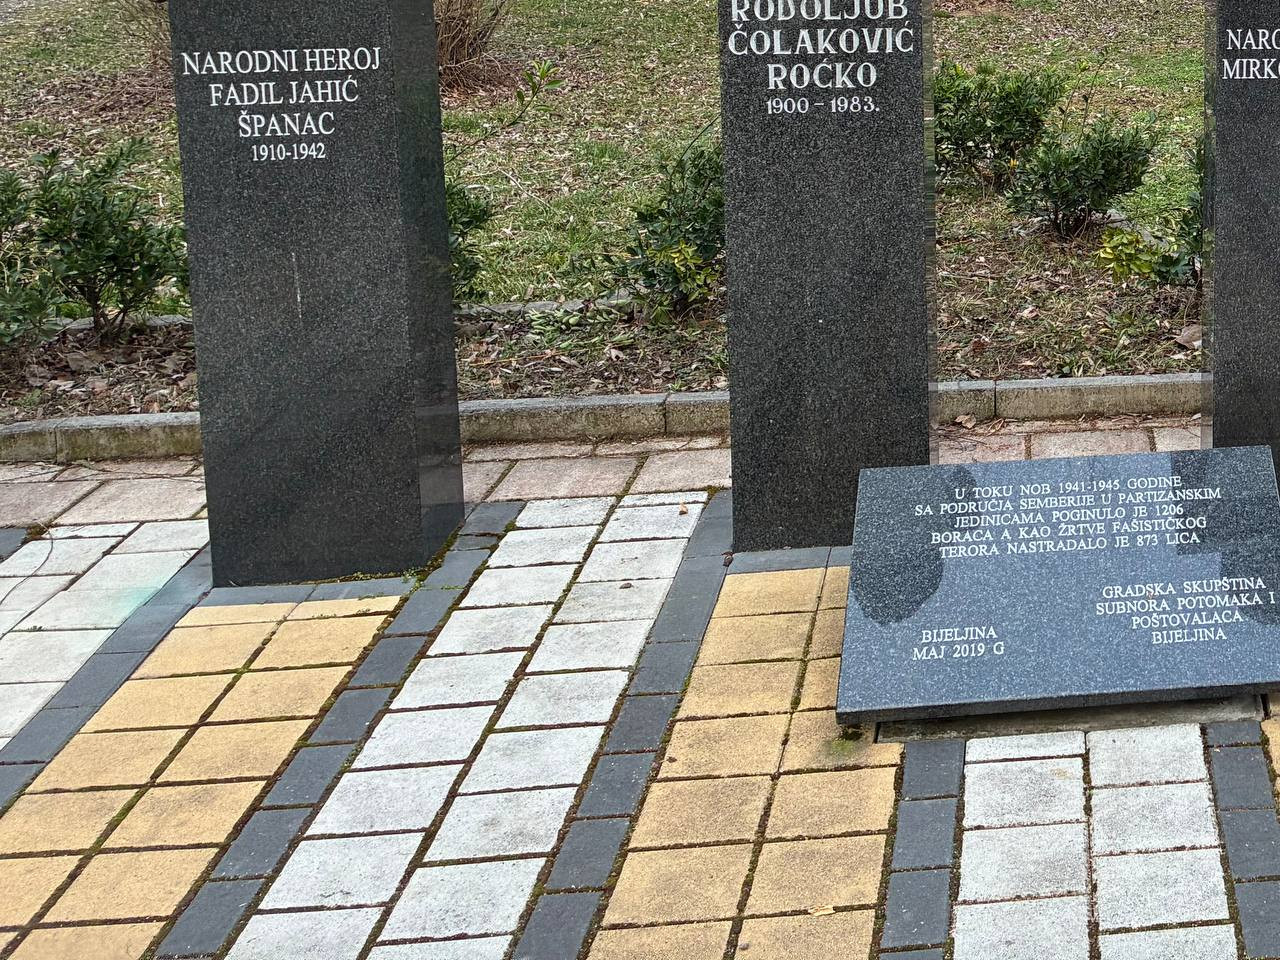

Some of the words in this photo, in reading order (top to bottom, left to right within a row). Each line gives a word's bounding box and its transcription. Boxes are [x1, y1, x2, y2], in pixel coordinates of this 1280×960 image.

[728, 21, 914, 56] ČOLAKOVIĆ
[181, 48, 298, 75] NARODNI
[303, 46, 381, 72] HEROJ
[767, 58, 877, 90] ROĆKO
[209, 81, 284, 107] FADIL
[289, 75, 359, 104] JAHIĆ
[767, 97, 809, 115] 1900
[830, 96, 880, 113] 1983.
[238, 110, 335, 138] ŠPANAC
[251, 142, 326, 162] 1910-1942
[955, 488, 965, 499] U
[972, 485, 1013, 499] TOKU
[1020, 483, 1051, 496] NOB
[1059, 479, 1120, 494] 1941-1945
[1127, 476, 1182, 490] GODINE
[915, 504, 933, 516] SA
[940, 499, 1013, 515] PODRUČJA
[1020, 495, 1095, 510] SEMBERIJE
[1101, 493, 1111, 505] U
[1118, 487, 1222, 504] PARTIZANSKIM
[954, 512, 1045, 528] JEDINICAMA
[1052, 507, 1126, 523] POGINULO
[1132, 506, 1147, 518] JE
[1156, 504, 1184, 516] 1206
[931, 529, 994, 544] BORACA
[1001, 528, 1012, 540] A
[1018, 526, 1051, 539] KAO
[1058, 522, 1105, 536] ŽRTVE
[1112, 516, 1207, 534] FAŠISTIČKOG
[939, 543, 999, 559] TERORA
[1007, 537, 1107, 555] NASTRADALO
[1114, 536, 1130, 548] JE
[1137, 534, 1159, 547] 873
[1166, 532, 1200, 545] LICA
[1102, 582, 1177, 599] GRADSKA
[1183, 576, 1266, 594] SKUPŠTINA
[1096, 598, 1170, 616] SUBNORA
[1177, 593, 1263, 610] POTOMAKA
[1269, 591, 1276, 604] I
[1132, 610, 1244, 630] POŠTOVALACA
[921, 625, 998, 643] BIJELJINA
[1152, 628, 1227, 645] BIJELJINA
[912, 645, 946, 661] MAJ
[953, 642, 985, 658] 2019
[993, 641, 1005, 655] G
